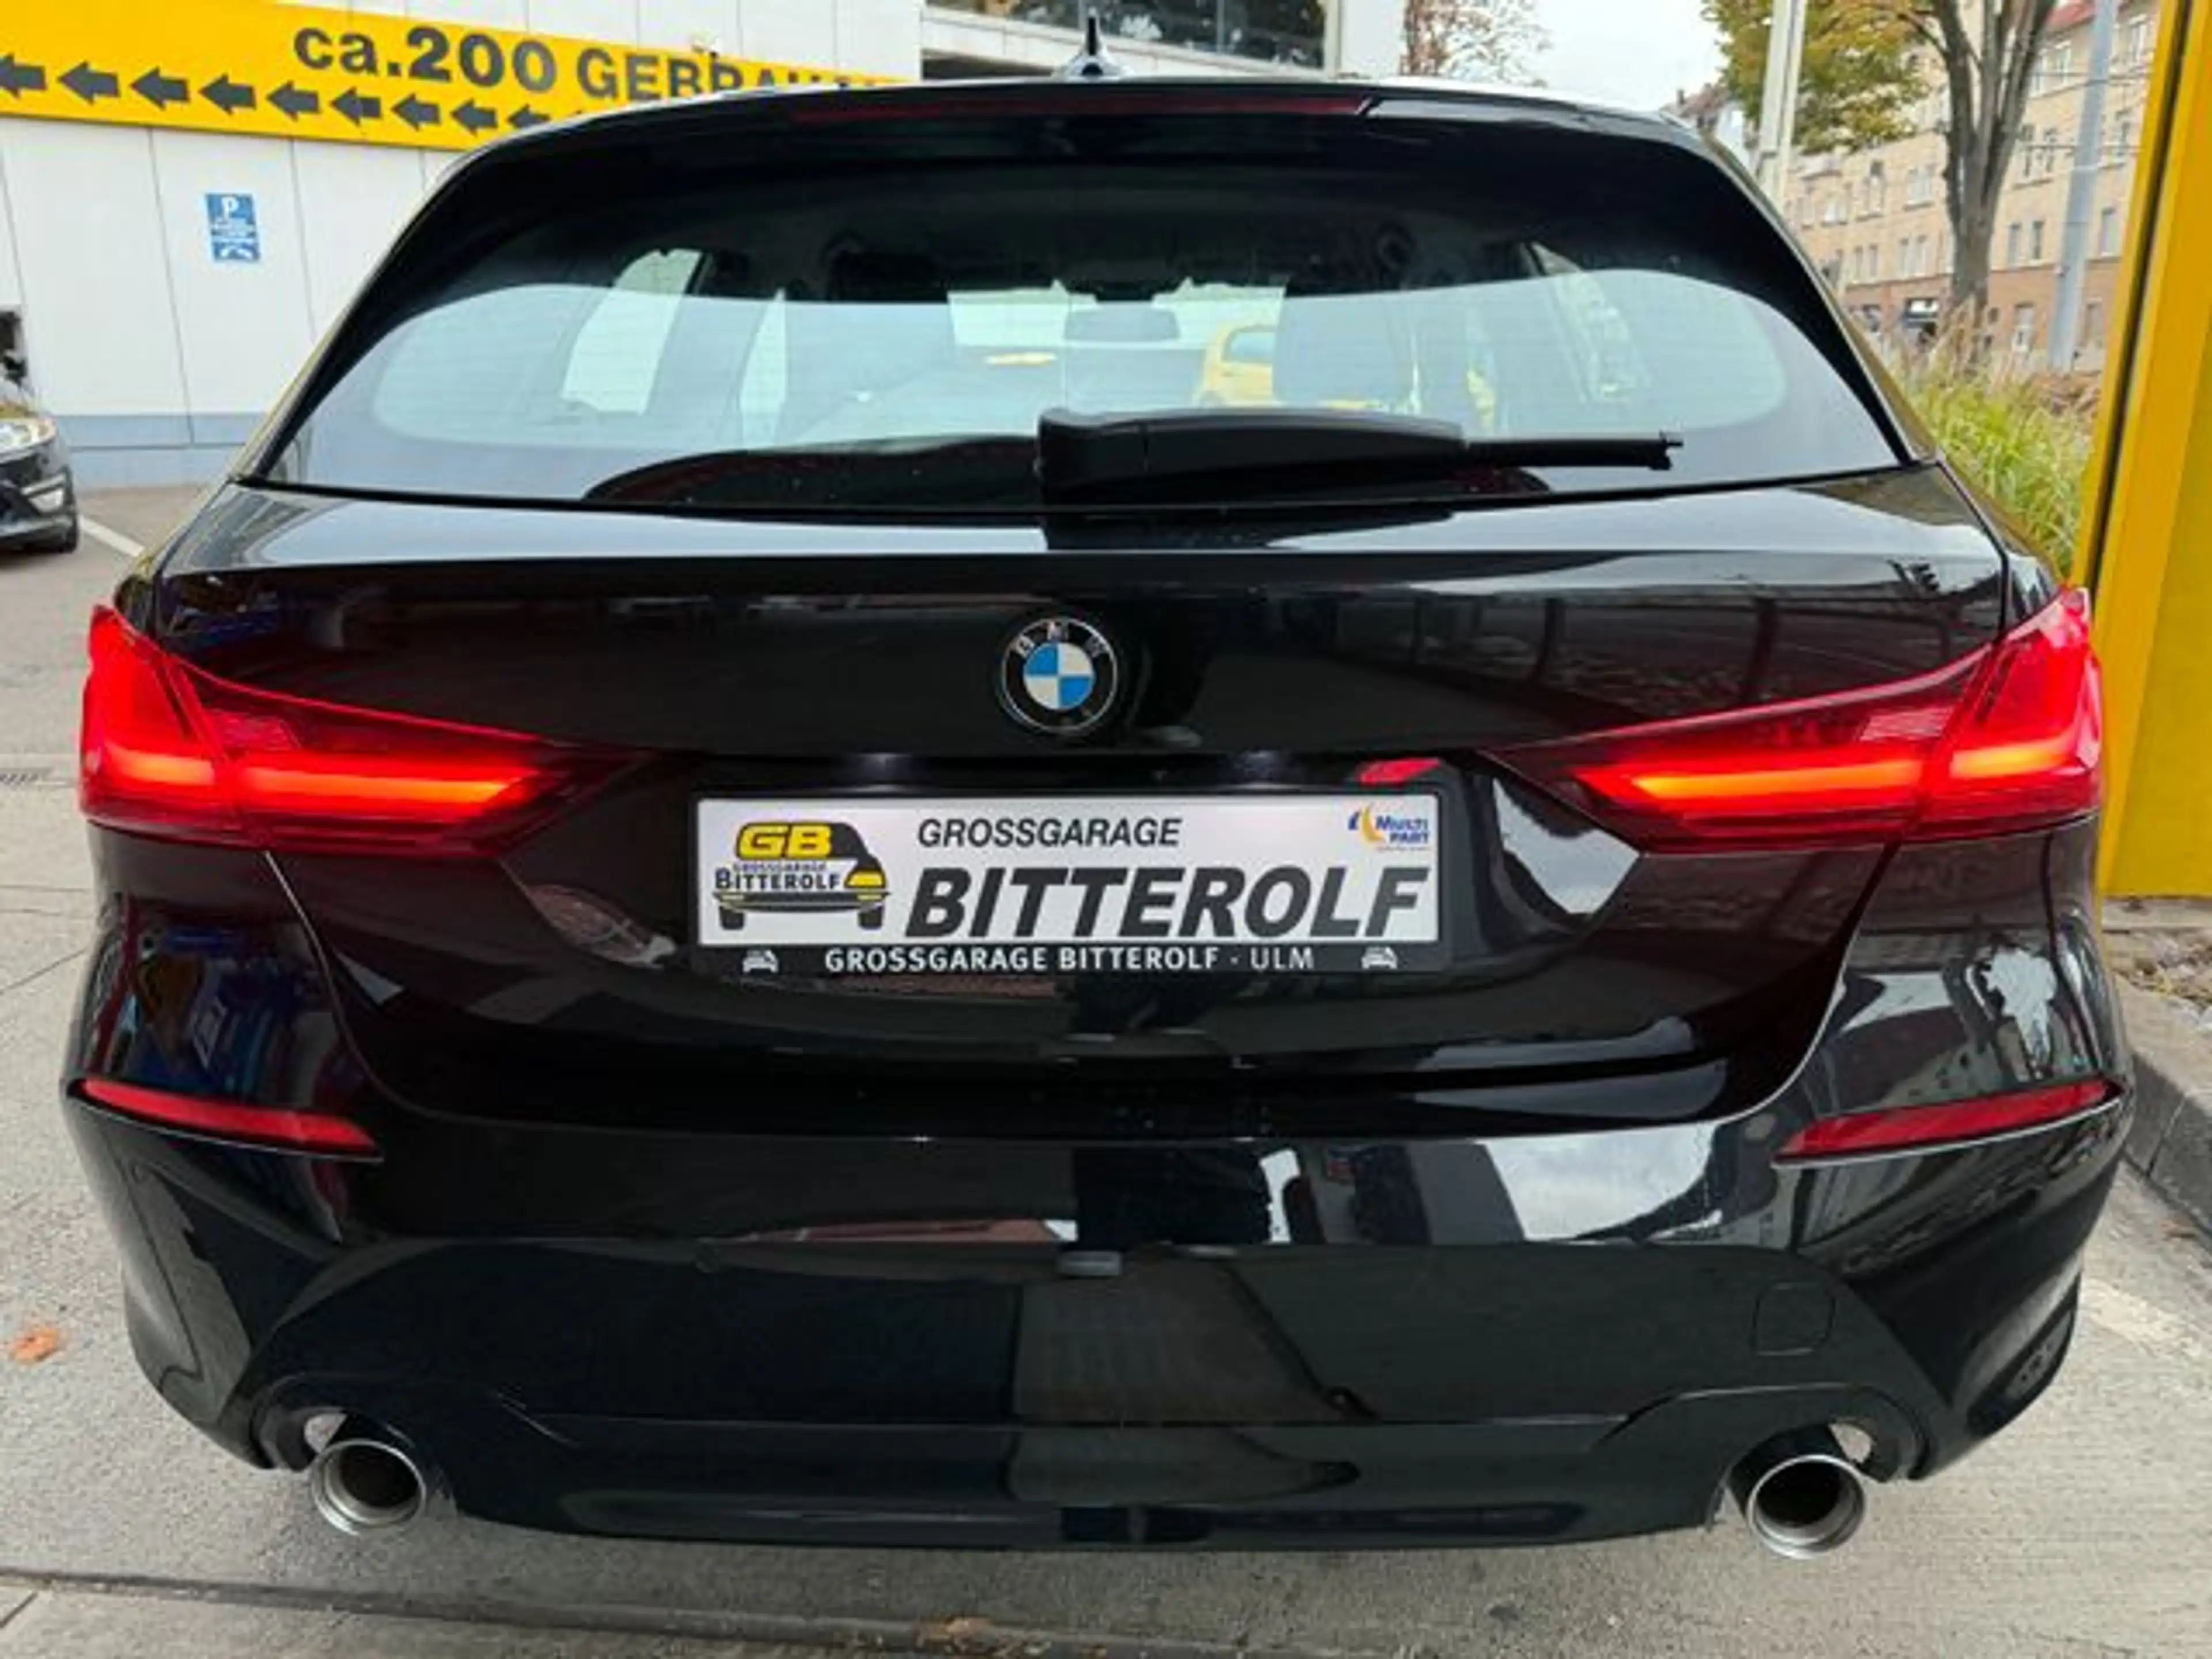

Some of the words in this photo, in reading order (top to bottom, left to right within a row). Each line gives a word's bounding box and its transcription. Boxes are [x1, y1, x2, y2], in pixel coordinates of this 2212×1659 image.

[293, 25, 557, 94] ca.200
[221, 196, 240, 218] P
[736, 823, 832, 859] GB
[916, 818, 1183, 849] GROSSGARAGE
[715, 868, 840, 890] BITTEROLF
[905, 866, 1430, 937] BITTEROLF
[824, 946, 1047, 972] GROSSGARAGE
[1058, 946, 1218, 971] BITTEROLF
[1251, 947, 1315, 969] ULM
